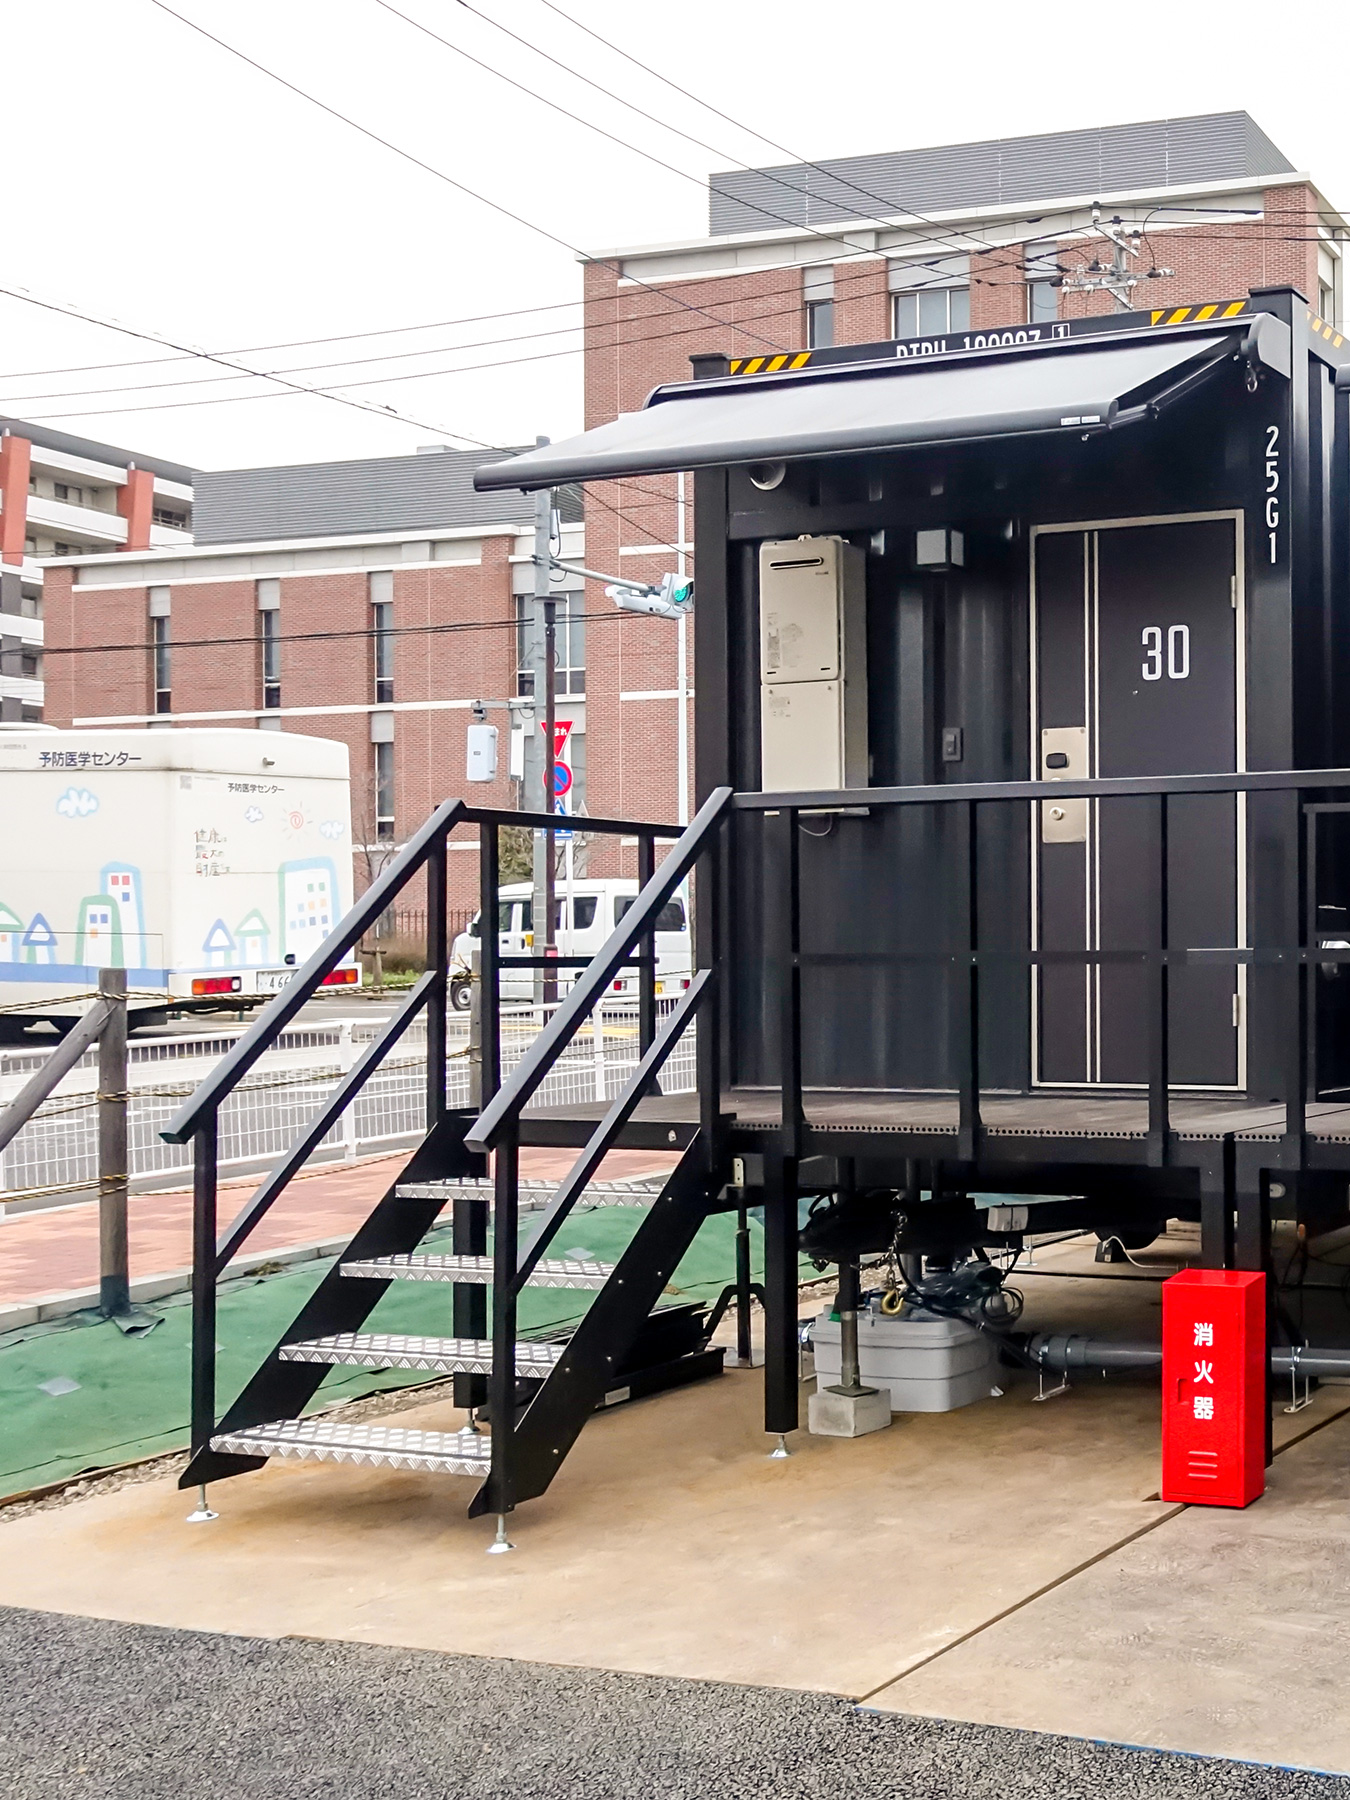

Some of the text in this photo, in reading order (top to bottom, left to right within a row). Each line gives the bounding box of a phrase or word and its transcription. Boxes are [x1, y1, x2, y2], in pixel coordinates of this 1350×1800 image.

[1265, 425, 1280, 564] 25G1
[1141, 624, 1190, 681] 30
[38, 751, 142, 767] 予防医学センター
[227, 782, 285, 794] 予防医学センター
[1193, 1322, 1214, 1420] 消火器
